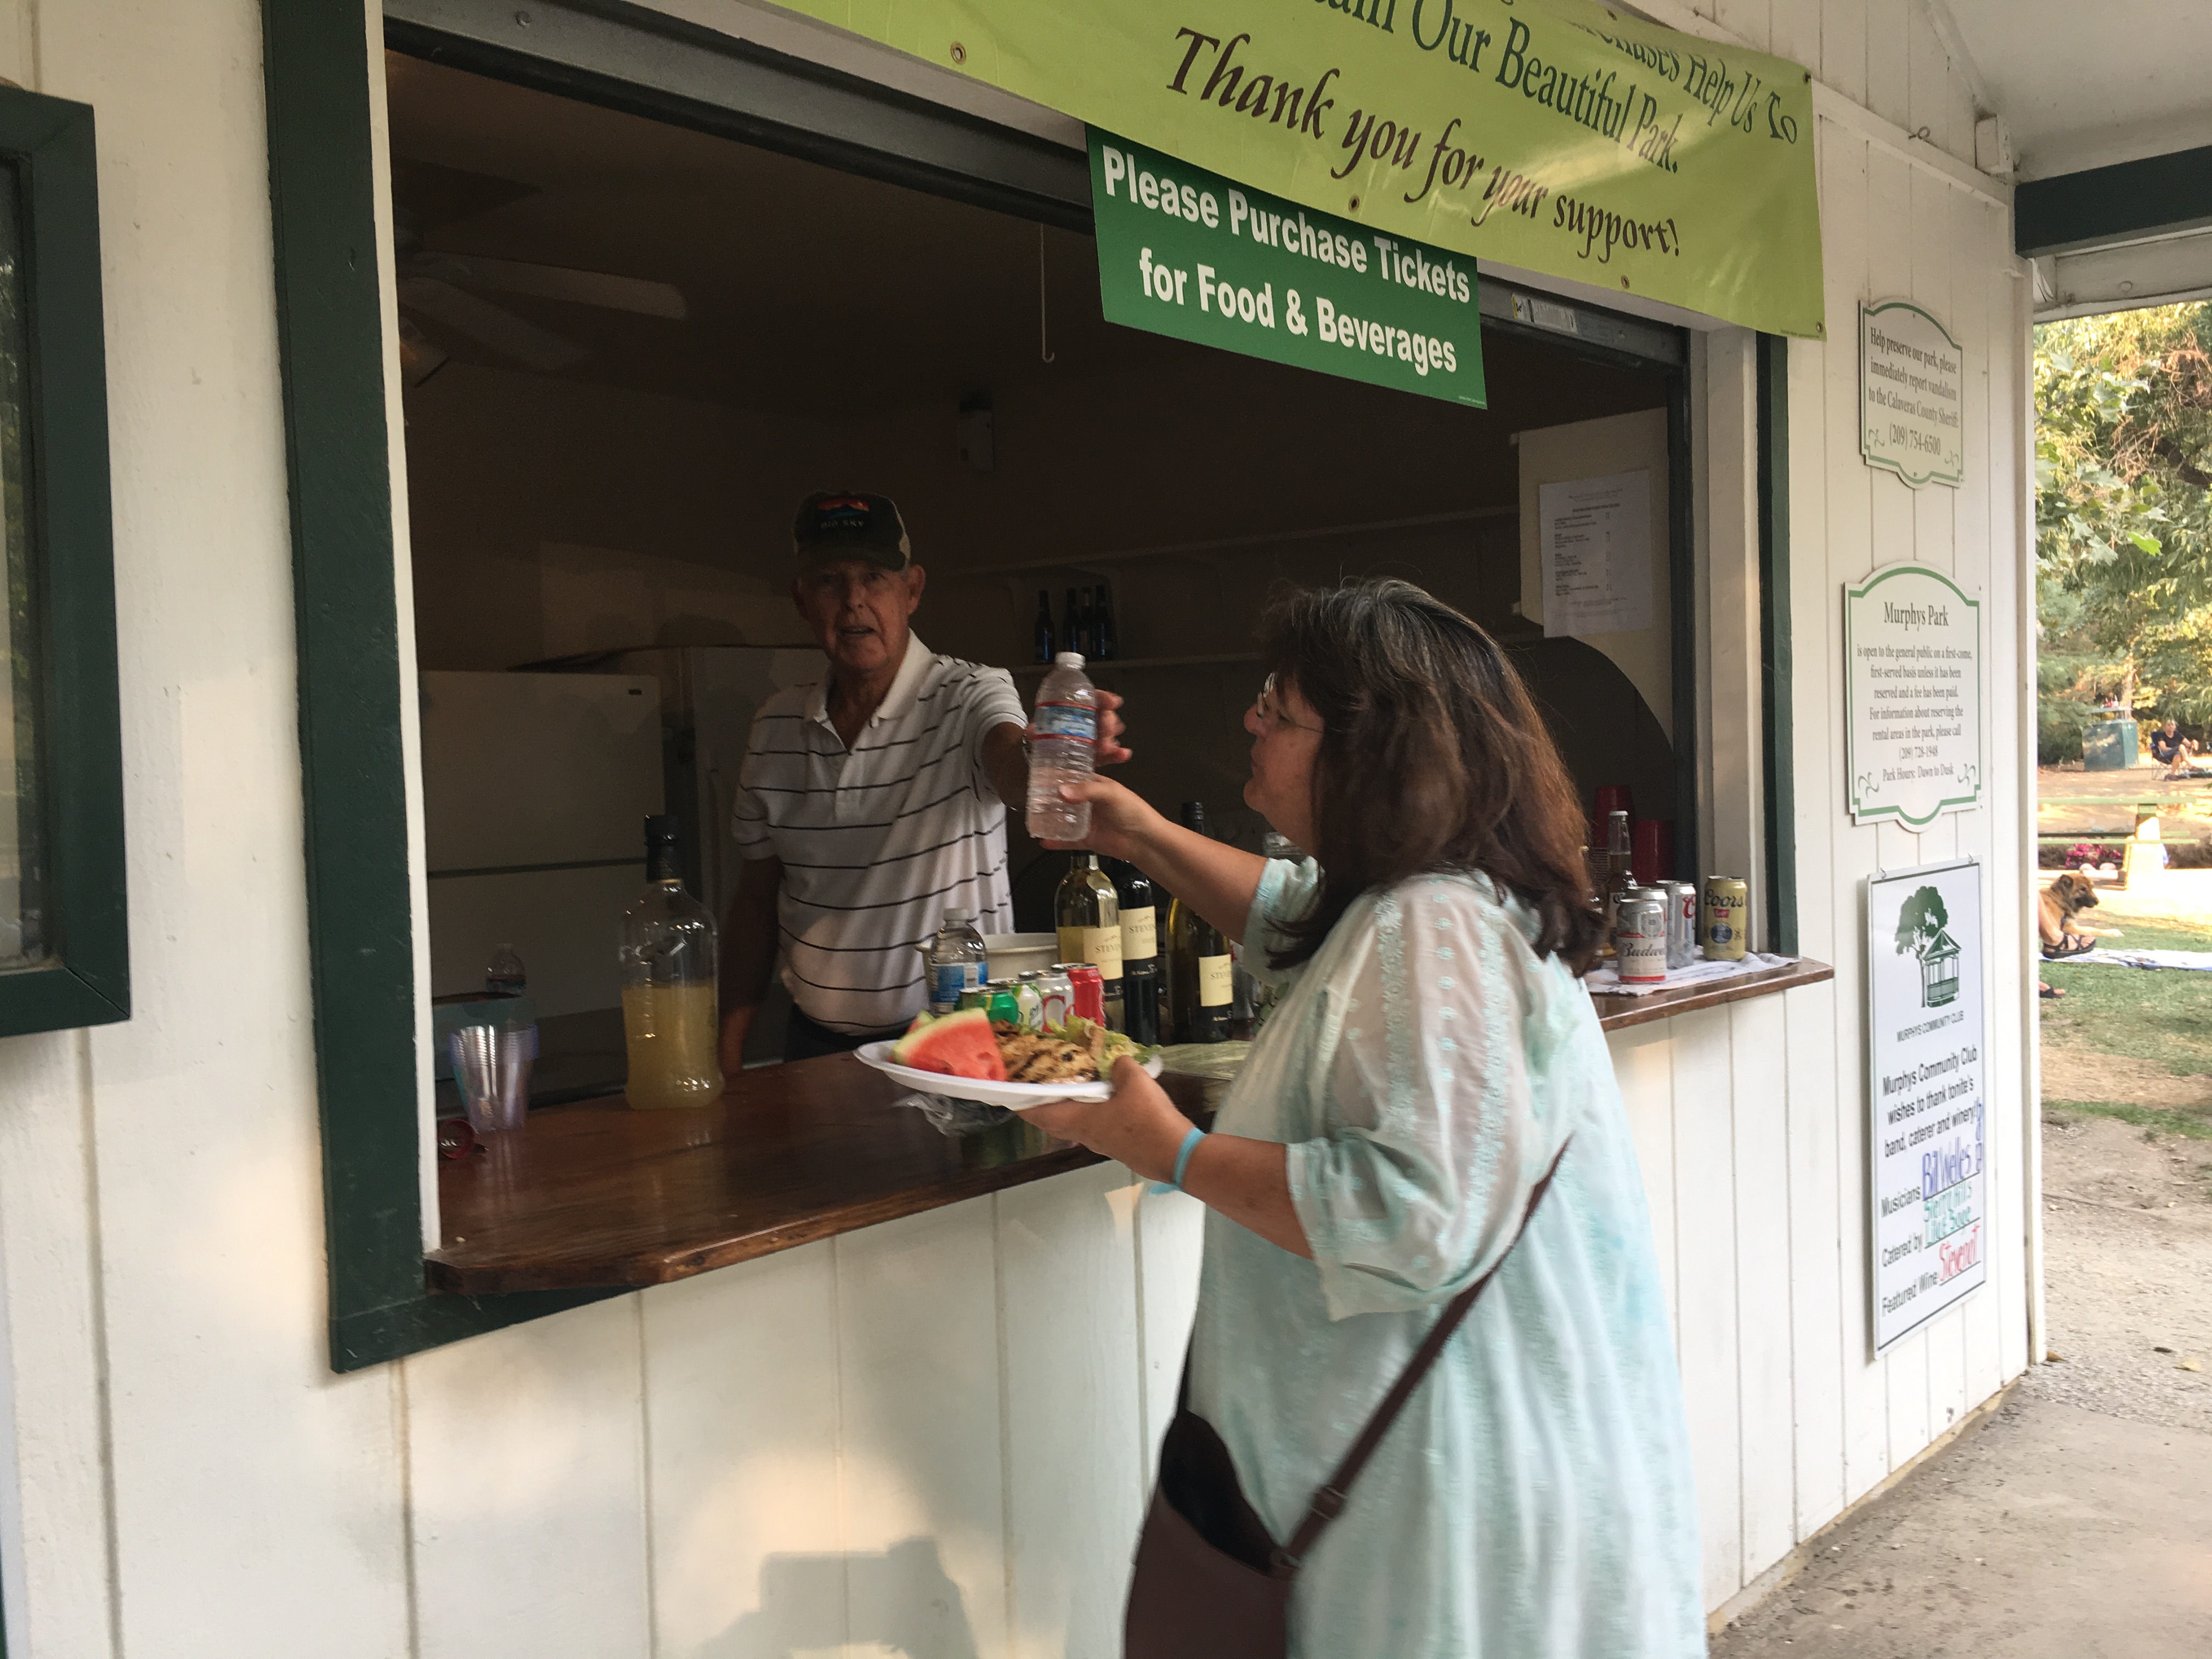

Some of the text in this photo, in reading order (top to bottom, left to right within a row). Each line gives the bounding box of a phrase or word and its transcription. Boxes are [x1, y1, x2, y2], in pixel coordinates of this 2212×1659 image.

[1412, 0, 1491, 72] Our
[1495, 16, 1637, 143] Beautiful
[1626, 93, 1683, 174] Park.
[1683, 53, 1735, 127] Help
[1731, 70, 1762, 133] Us
[1765, 91, 1797, 144] To
[1166, 26, 1680, 264] Thank you for your support!
[1102, 144, 1470, 303] Please Purchase Tickets
[1139, 247, 1187, 306] for
[1197, 263, 1276, 329] Food
[1285, 288, 1308, 336] &
[1316, 296, 1457, 376] Beverages
[1871, 326, 1957, 375] Help preserve our park, please
[1871, 356, 1957, 402] immediately report vandalism
[1869, 386, 1876, 402] to
[1876, 387, 1887, 406] the
[1887, 390, 1916, 415] Calaveras
[1917, 400, 1938, 426] County
[1889, 422, 1908, 450] (209)
[842, 519, 865, 528] SKY
[1884, 601, 1949, 631] Murphys Park
[1857, 643, 1863, 657] is
[1863, 647, 1878, 661] open
[1878, 646, 1884, 658] to
[1885, 644, 1895, 658] the
[1895, 645, 1916, 662] general
[1916, 645, 1933, 662] public
[1933, 649, 1941, 659] on
[1903, 665, 1917, 679] basis
[1917, 665, 1934, 679] unless
[1934, 665, 1939, 679] it
[1939, 665, 1949, 679] has
[1949, 665, 1962, 679] been
[1874, 685, 1898, 699] reserved
[1899, 685, 1909, 699] and
[1914, 685, 1922, 698] fee
[1923, 685, 1932, 698] has
[1932, 684, 1945, 698] been
[1869, 704, 1963, 721] For information about reserving the
[1872, 726, 1889, 741] rental
[1889, 729, 1904, 740] areas
[1905, 727, 1912, 739] in
[1912, 725, 1921, 739] the
[1936, 724, 1952, 741] please
[1883, 767, 1897, 782] Park
[1940, 762, 1955, 776] Dusk
[1897, 1024, 1922, 1042] MURPHYS
[1921, 1015, 1951, 1034] COMMUNITY
[1882, 1043, 1978, 1097] Murphys Community Club
[1887, 1101, 1916, 1125] wishes
[1916, 1096, 1926, 1114] to
[1926, 1085, 1948, 1109] thank
[1884, 1138, 1908, 1158] band,
[1908, 1122, 1936, 1147] caterer
[1936, 1111, 1951, 1135] and
[1881, 1186, 1921, 1218] Musicians
[1882, 1232, 1924, 1268] Catered by
[1882, 1272, 1938, 1318] Featured Wine
